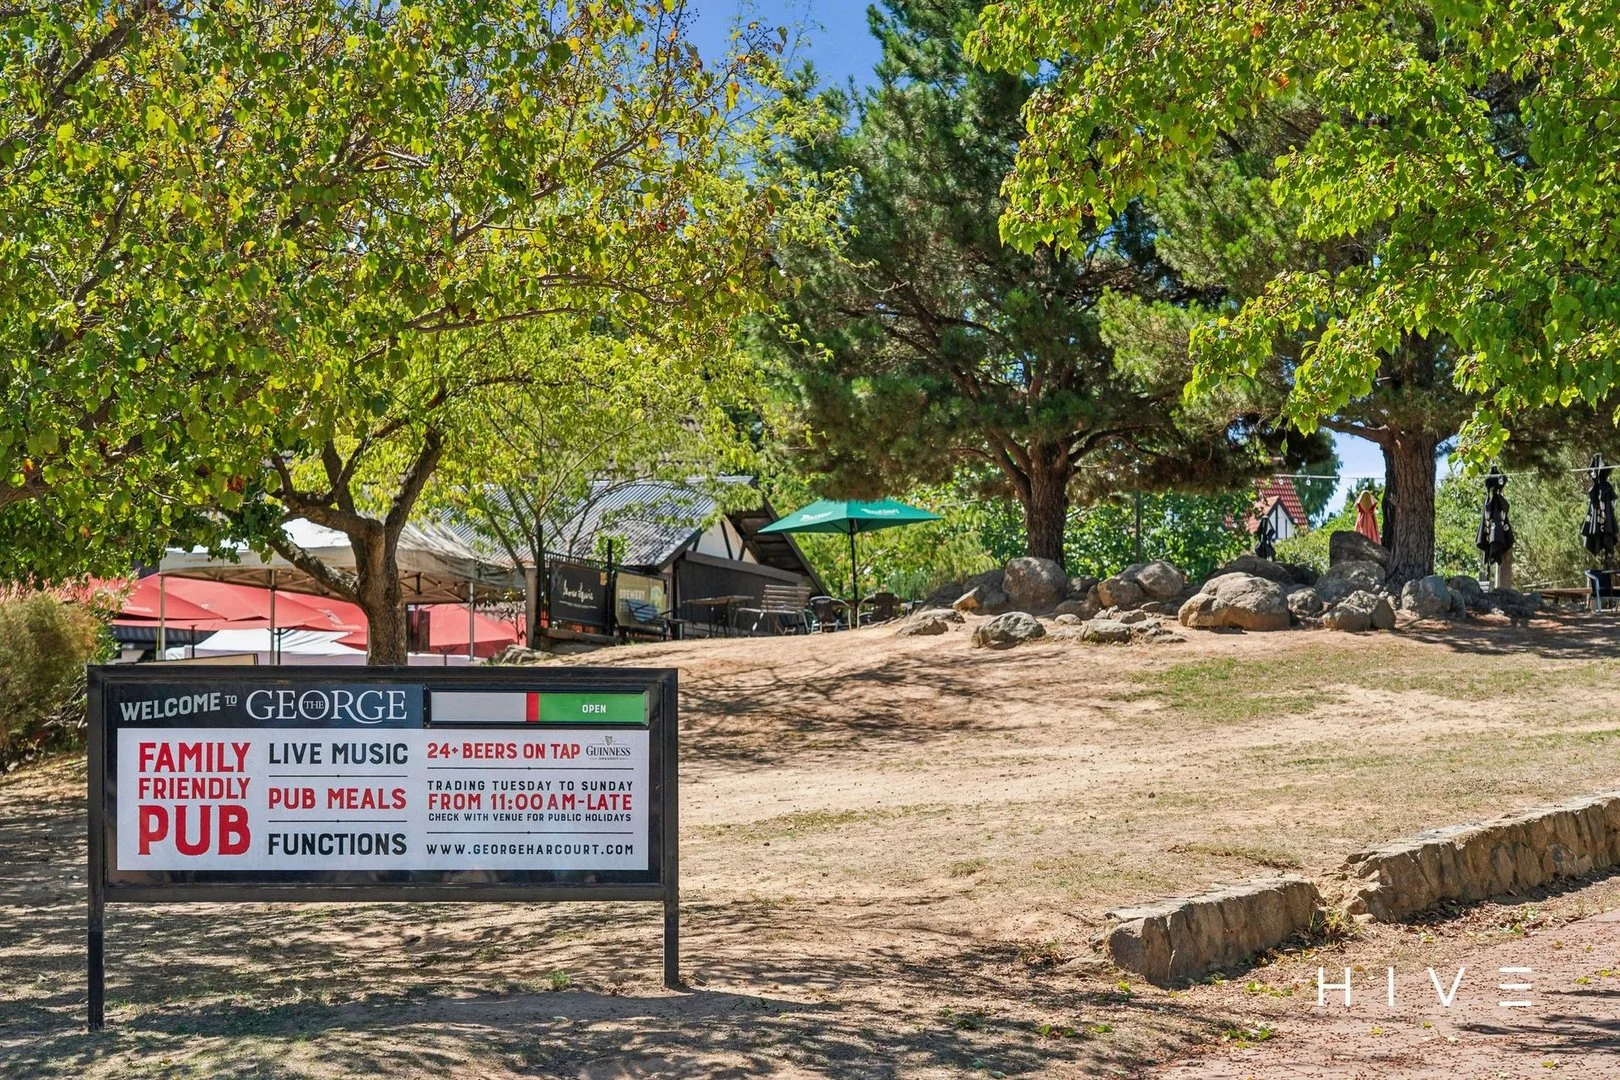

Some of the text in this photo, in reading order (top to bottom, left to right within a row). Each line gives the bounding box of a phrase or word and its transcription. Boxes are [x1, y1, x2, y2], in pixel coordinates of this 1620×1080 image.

[120, 692, 238, 721] WELCOME TO
[245, 689, 408, 724] GEORGE
[303, 700, 324, 709] THE
[582, 704, 607, 714] OPEN
[138, 742, 251, 773] FAMILY
[269, 742, 409, 765] LIVE MUSIC
[427, 742, 581, 759] 24+ BEERS ON TAP
[585, 745, 631, 756] GUINNESS
[138, 777, 251, 800] FRIENDLY
[427, 780, 633, 792] TRADING TUESDAY TO SUNDAY
[268, 787, 407, 810] PUB MEALS
[428, 793, 481, 811] FROM
[428, 813, 631, 822] CHECK WITH VENUE FOR PUBLIC HOLIDAYS
[138, 804, 251, 856] PUB
[268, 833, 407, 856] FUNCTIONS
[426, 844, 634, 856] WWW.GEORGEHARCOURT.COM
